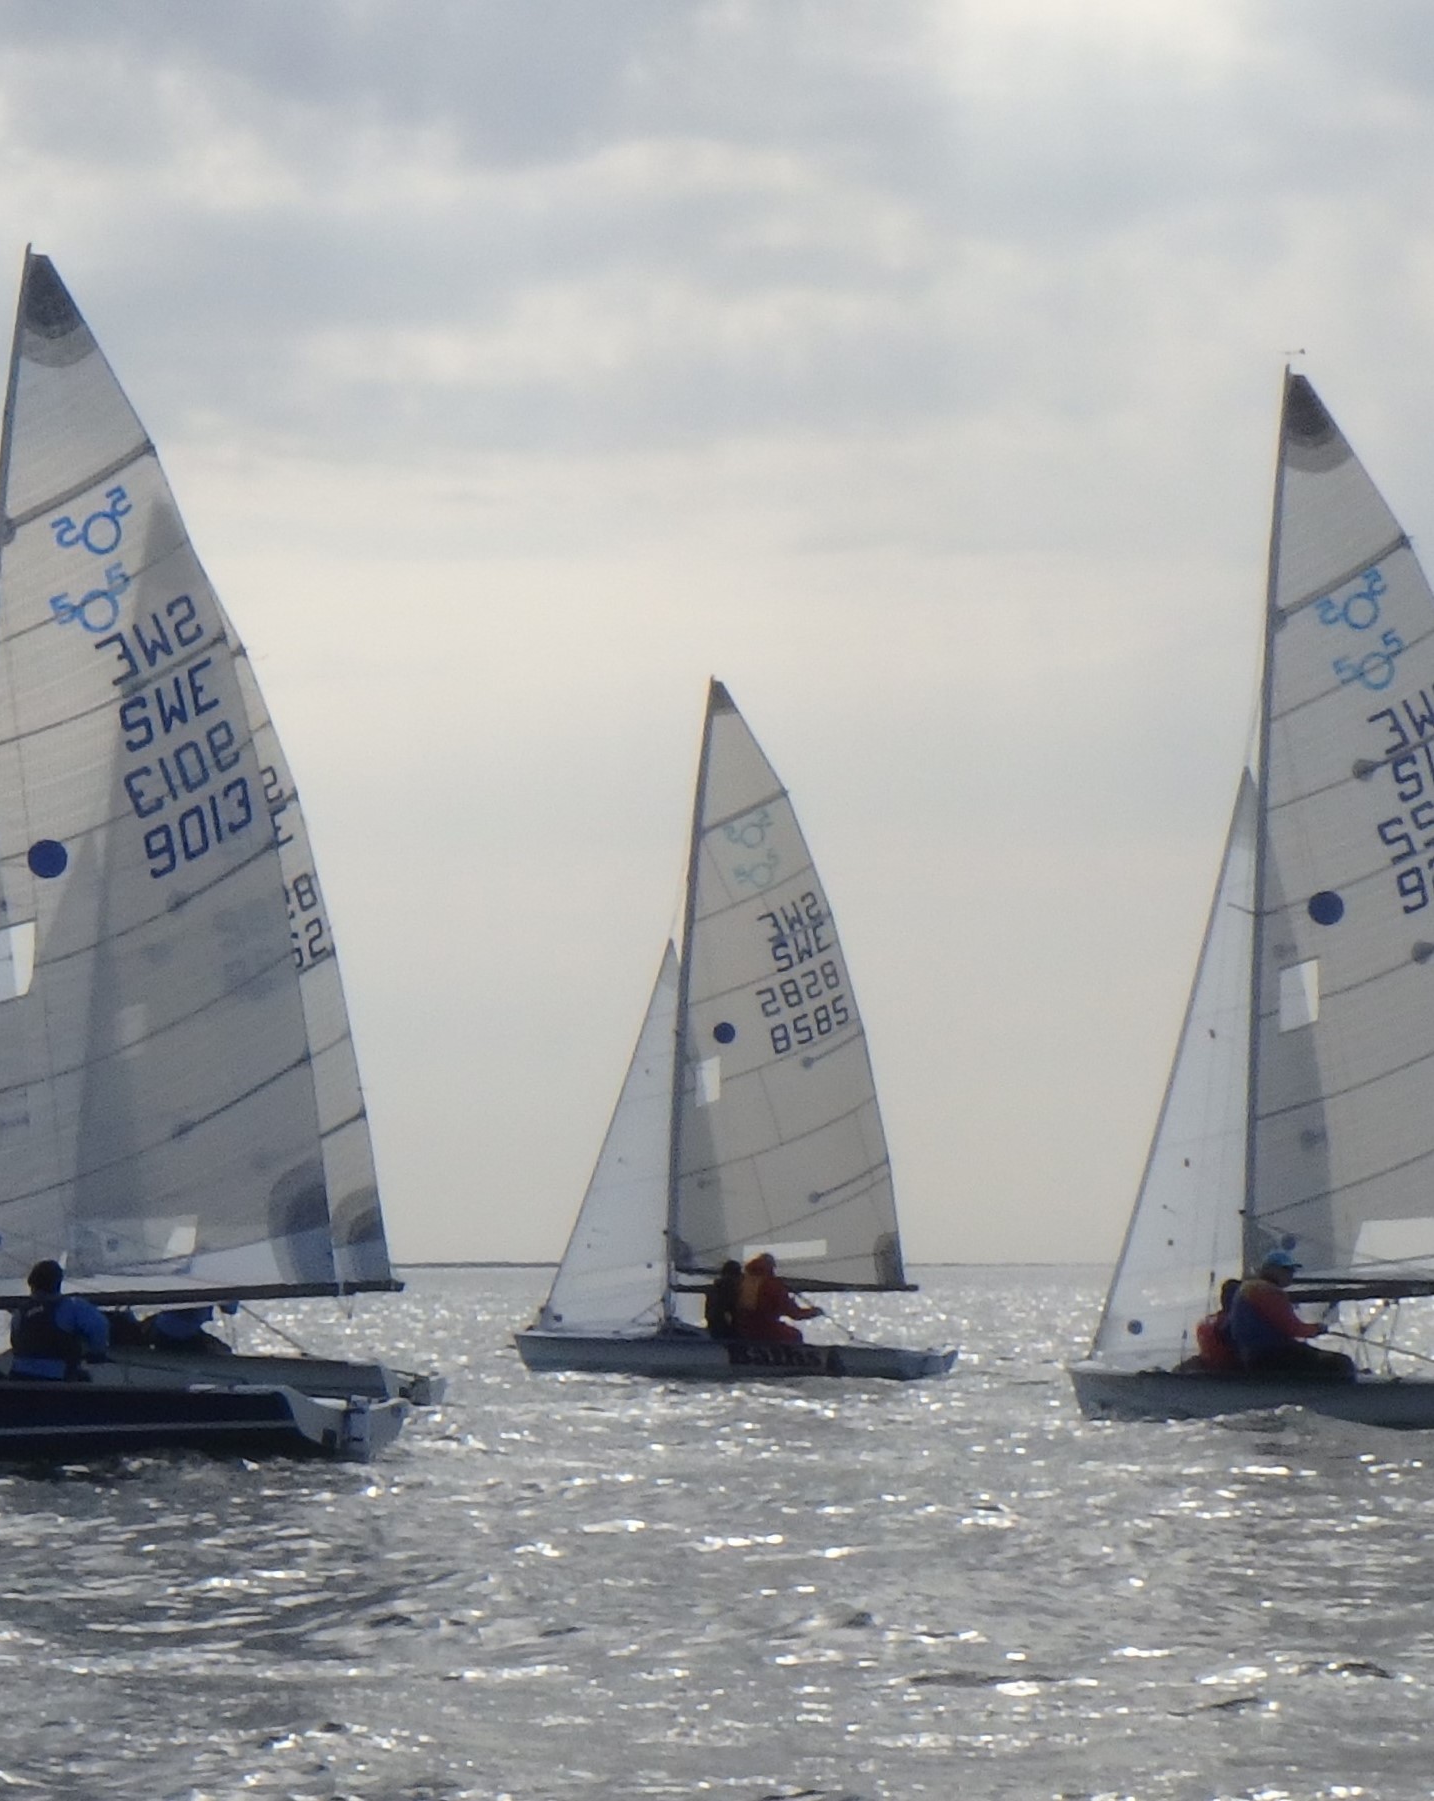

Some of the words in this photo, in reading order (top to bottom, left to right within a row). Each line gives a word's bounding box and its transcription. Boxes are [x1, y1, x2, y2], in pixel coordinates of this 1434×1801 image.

[119, 659, 220, 752] SWE
[143, 776, 254, 879] 9013
[770, 994, 849, 1055] 8585
